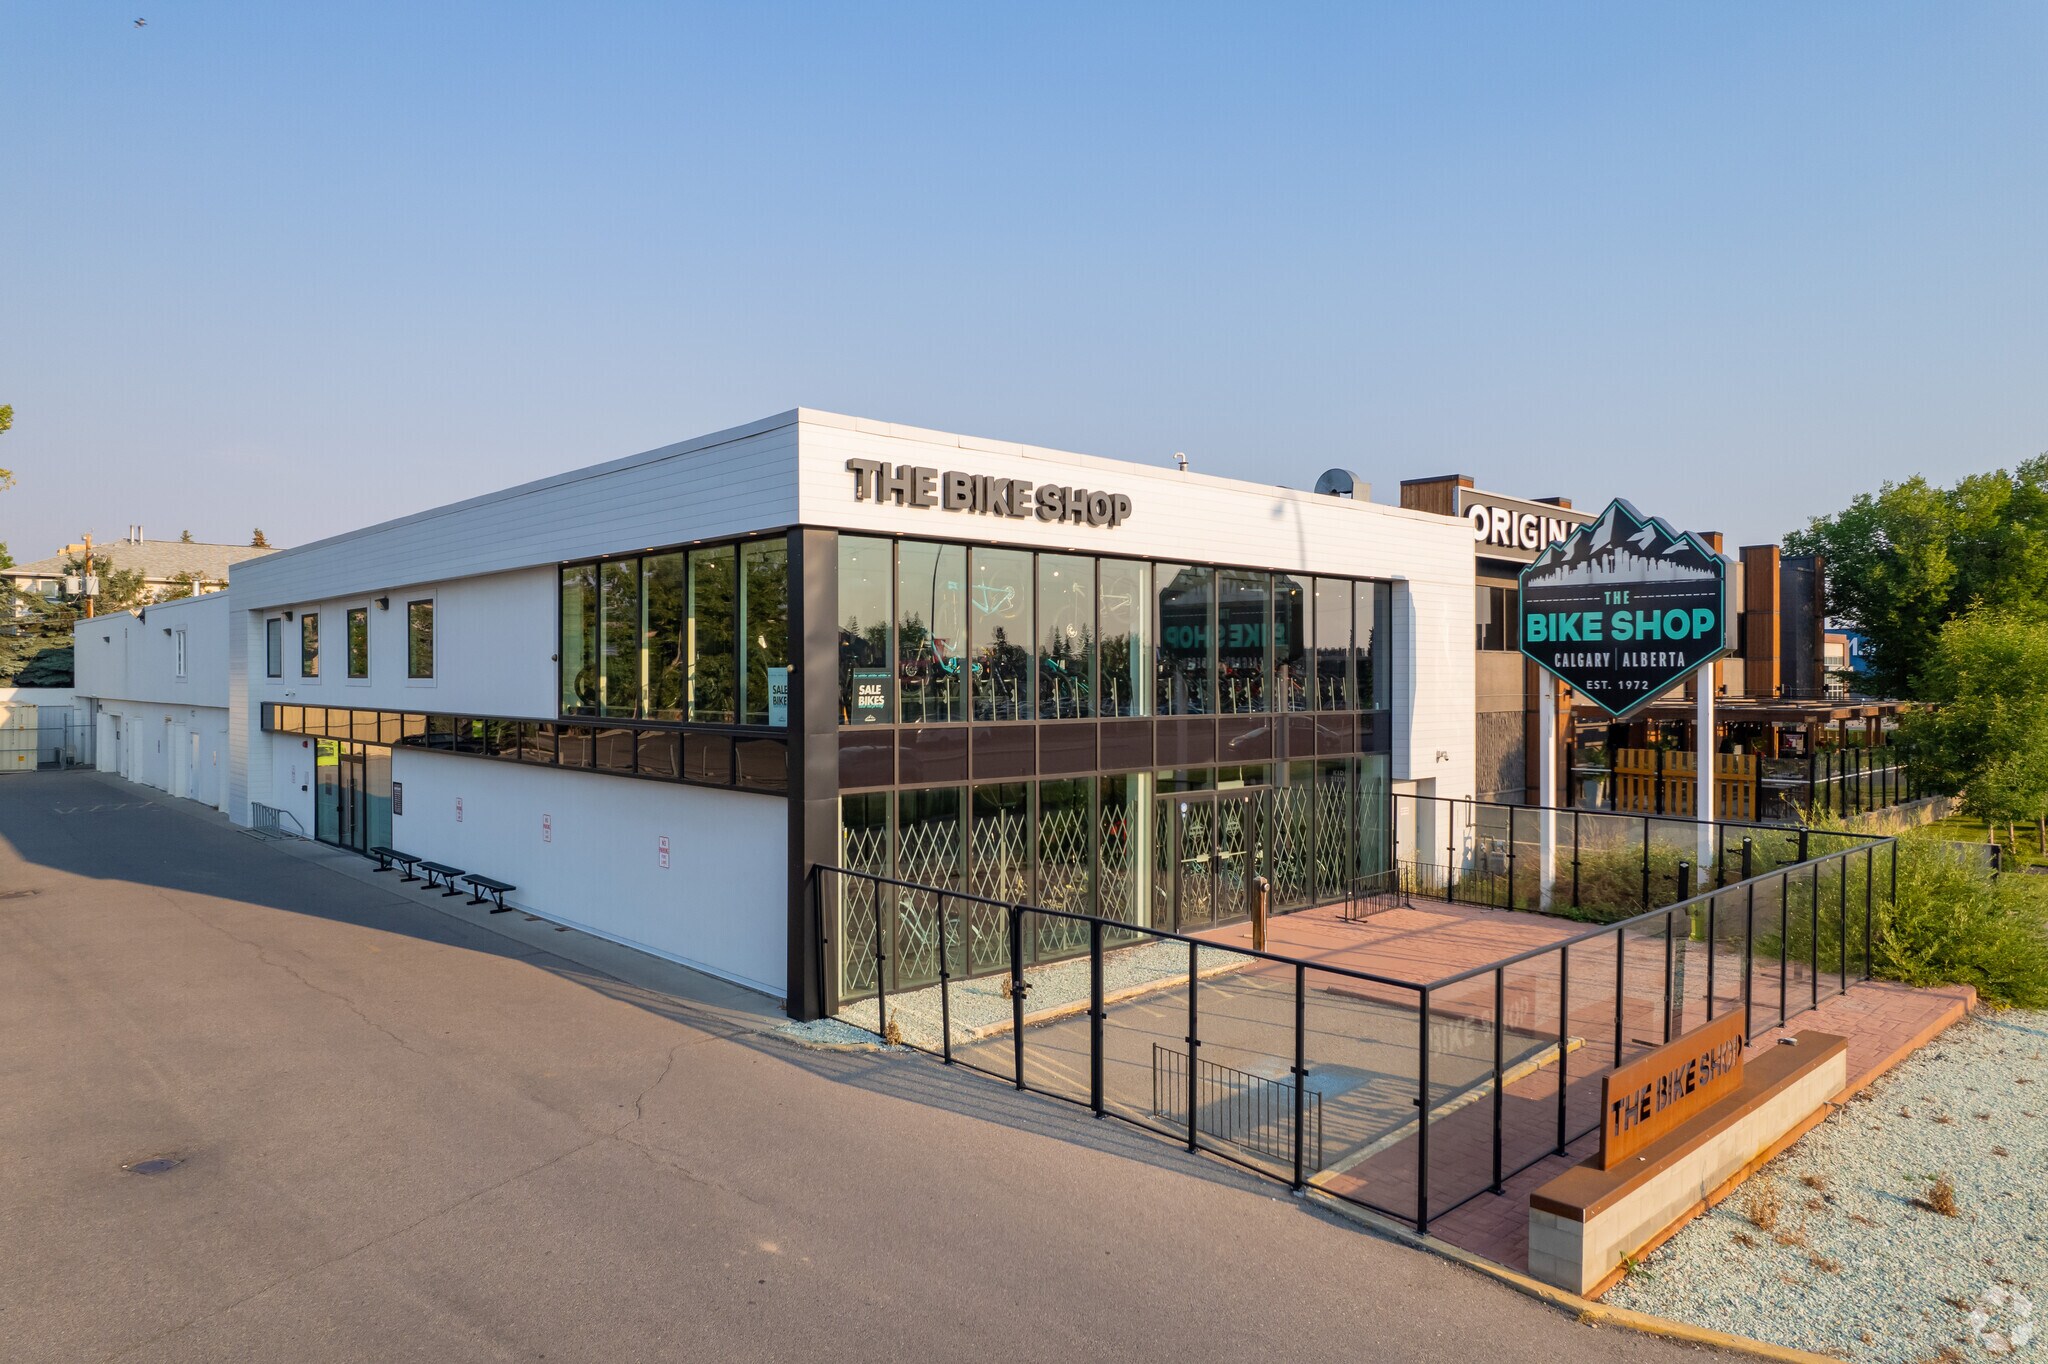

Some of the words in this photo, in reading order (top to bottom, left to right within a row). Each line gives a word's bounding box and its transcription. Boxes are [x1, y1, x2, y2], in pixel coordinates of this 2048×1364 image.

[847, 458, 938, 506] THE
[942, 471, 1033, 520] BIKE
[1035, 484, 1132, 528] SHOP
[1467, 504, 1580, 551] ORIGIN
[1604, 590, 1630, 605] THE
[1527, 611, 1603, 642] BIKE
[1611, 608, 1715, 641] SHOP
[1554, 652, 1610, 668] CALGARY
[1622, 651, 1685, 668] ALBERTA
[772, 684, 788, 695] SALE
[858, 684, 882, 695] SALE
[1586, 680, 1612, 690] EST.
[1618, 680, 1649, 690] 1972
[857, 695, 885, 706] BIKES
[1611, 1083, 1652, 1136] THE
[1656, 1059, 1696, 1113] BIKE
[1699, 1034, 1742, 1087] SHOP
